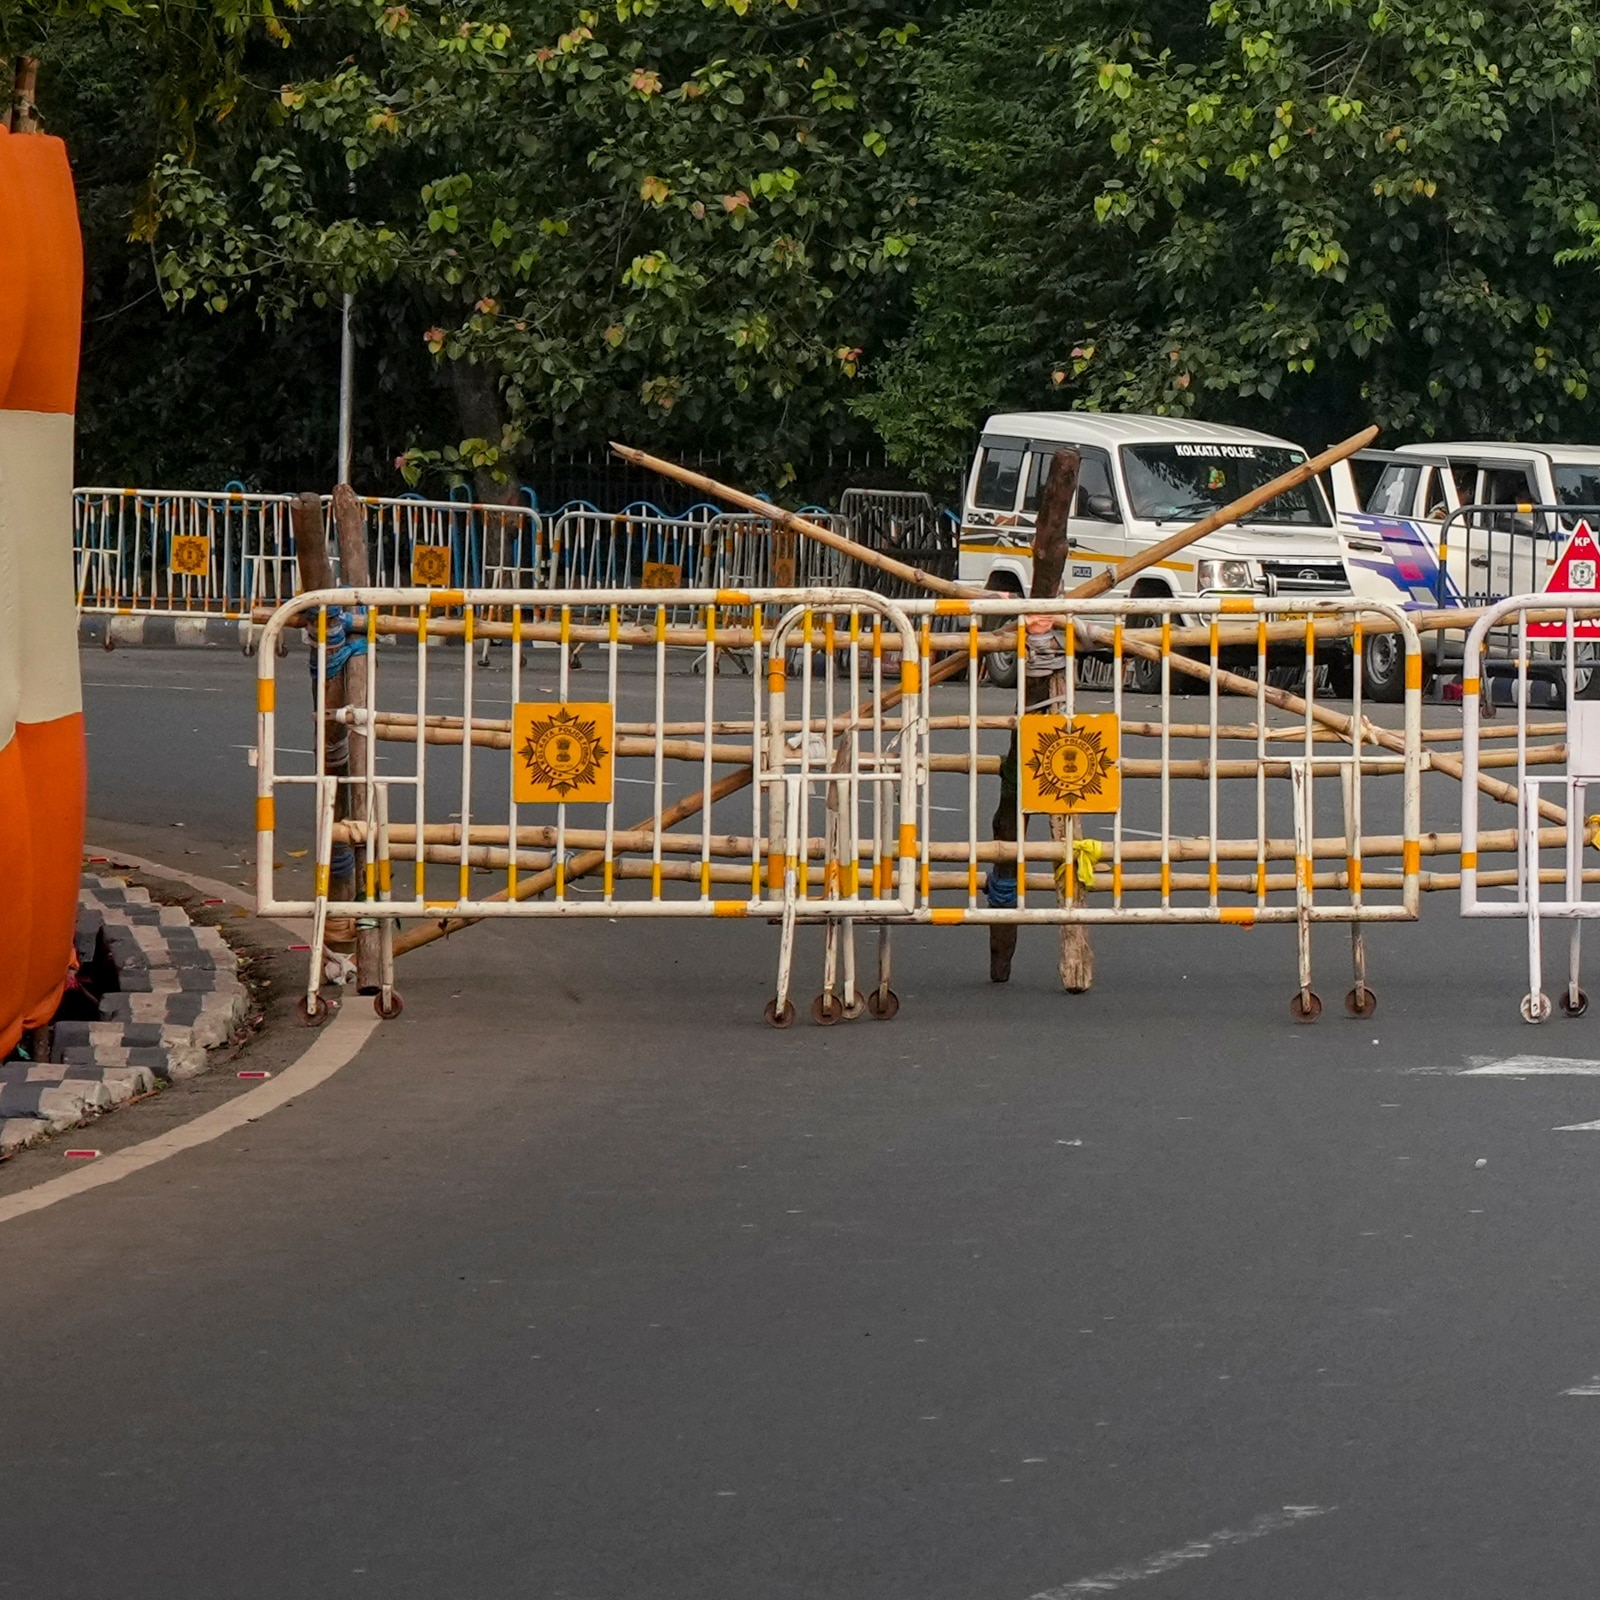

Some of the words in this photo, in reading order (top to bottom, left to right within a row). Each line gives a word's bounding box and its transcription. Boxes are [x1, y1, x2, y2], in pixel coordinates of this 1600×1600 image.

[1174, 444, 1221, 457] KOLKATA
[1221, 446, 1256, 458] POLICE
[1574, 537, 1591, 547] KP
